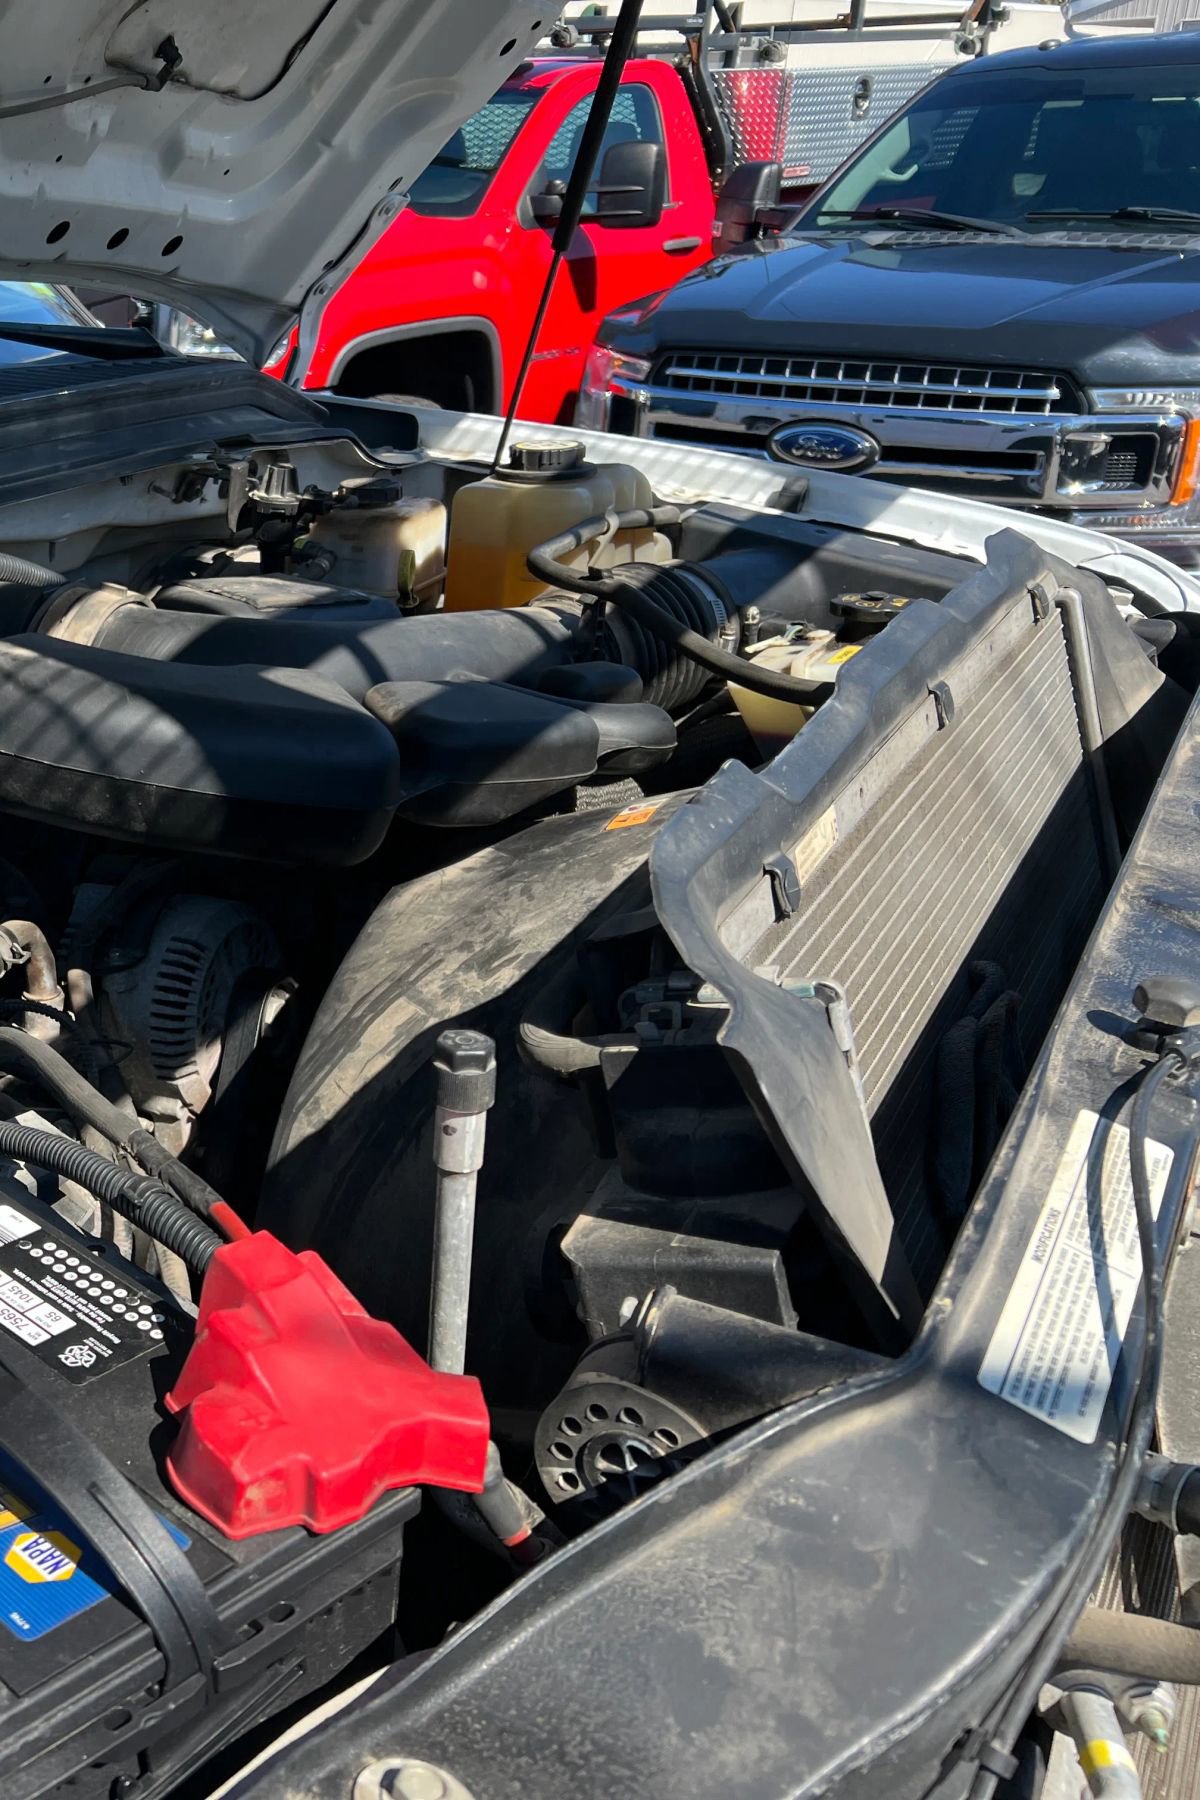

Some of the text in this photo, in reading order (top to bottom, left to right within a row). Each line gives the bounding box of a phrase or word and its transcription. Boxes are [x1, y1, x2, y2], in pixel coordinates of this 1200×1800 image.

[791, 434, 845, 460] Ford
[1031, 1207, 1063, 1265] MODIFICATIONS
[6, 1284, 35, 1304] 1045
[43, 1310, 62, 1323] 65
[21, 1535, 71, 1575] NAPA
